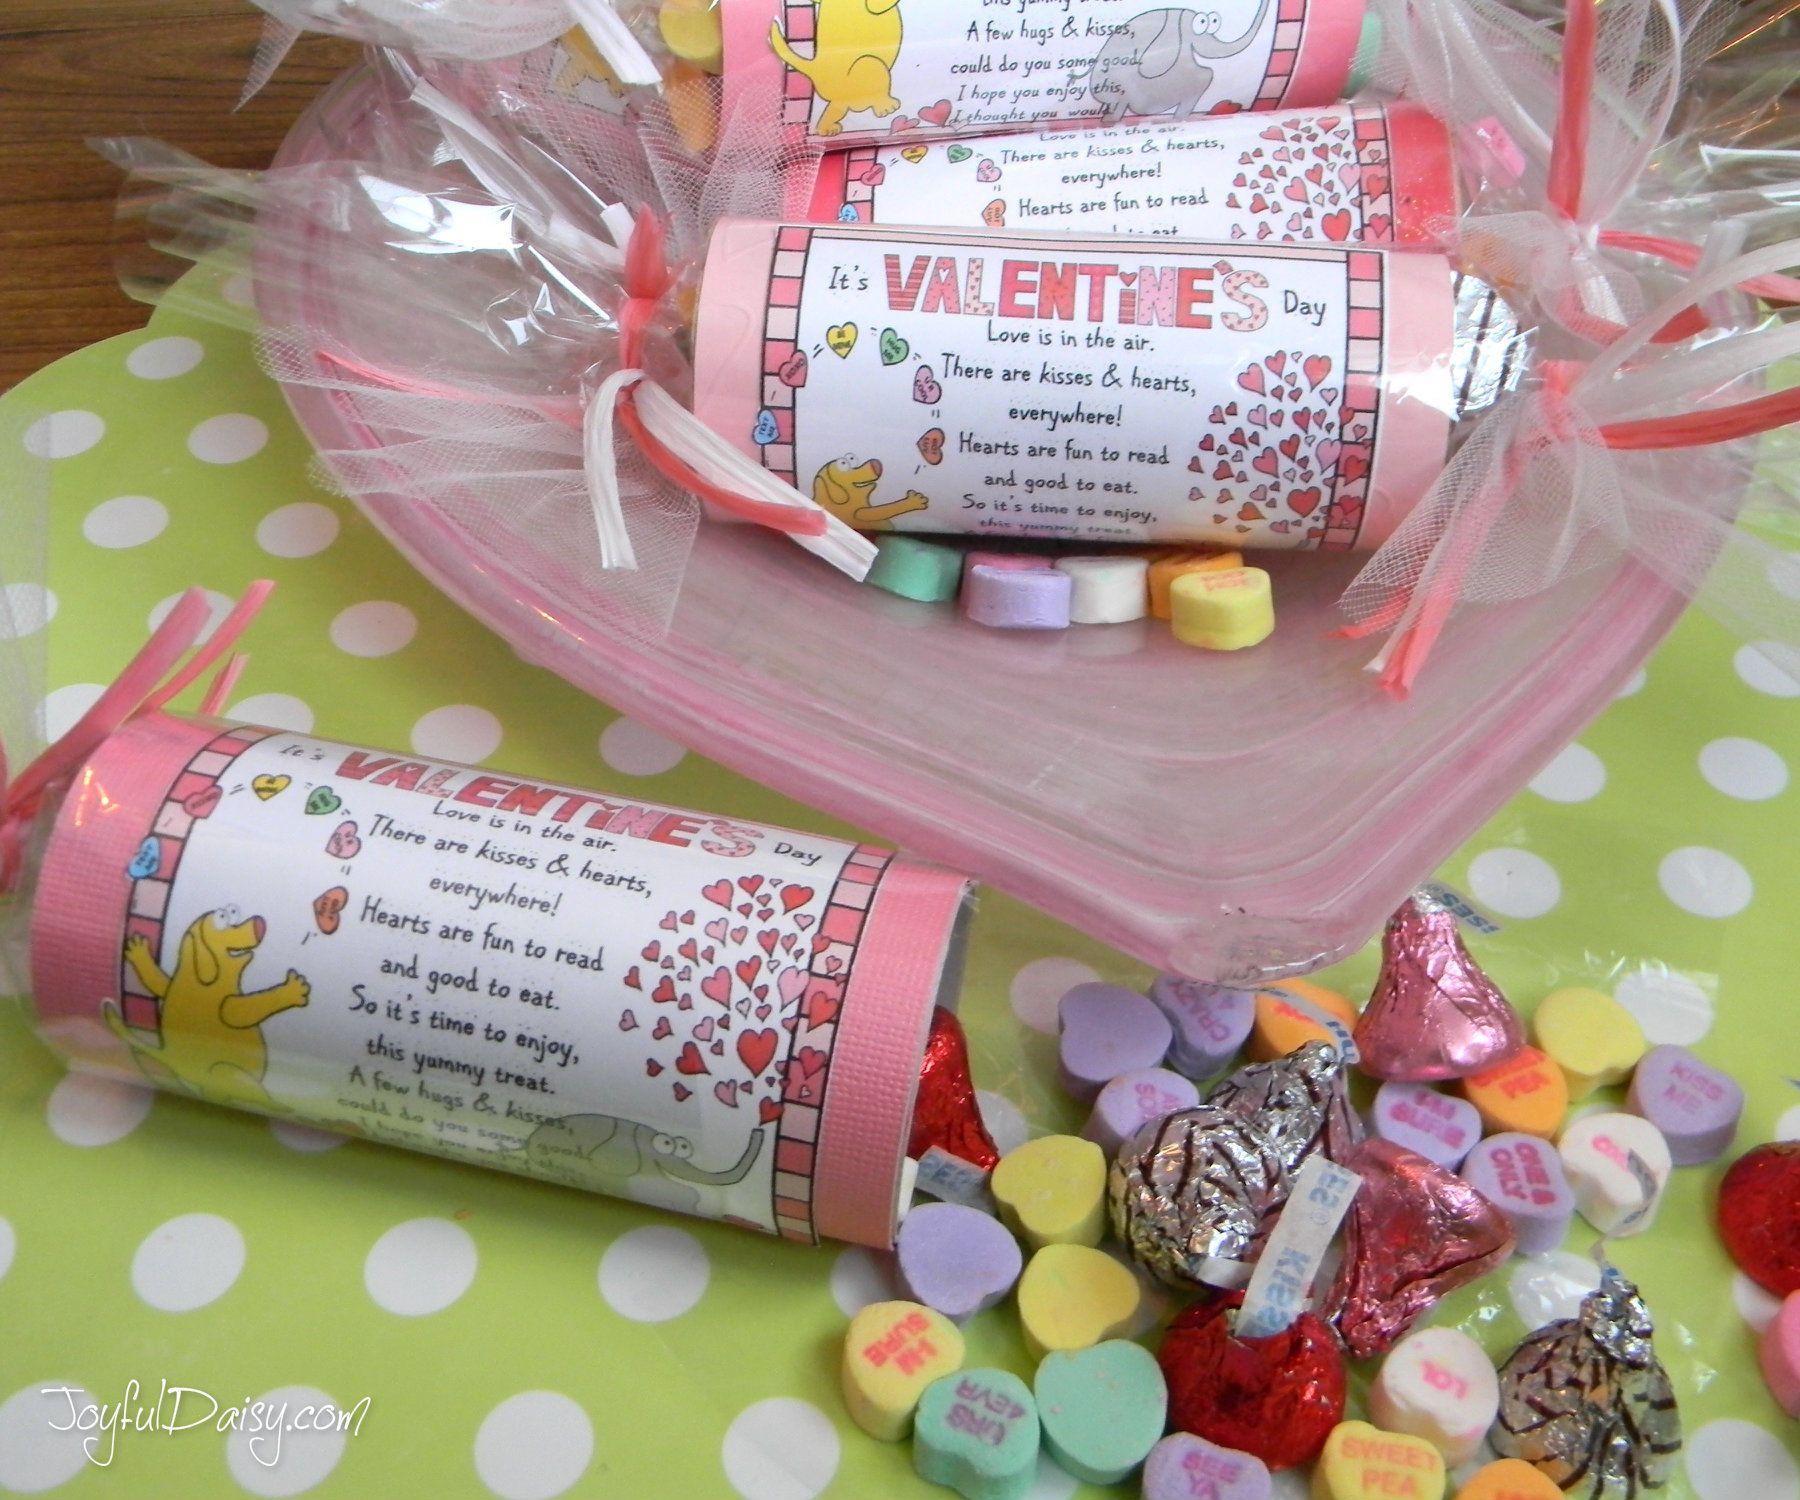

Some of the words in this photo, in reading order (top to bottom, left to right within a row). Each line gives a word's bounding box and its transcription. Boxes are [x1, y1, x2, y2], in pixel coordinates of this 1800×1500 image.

[966, 20, 979, 42] A
[986, 20, 1014, 42] few
[1020, 19, 1054, 46] hugs
[1062, 16, 1080, 39] &
[1085, 17, 1135, 40] kisses,
[950, 55, 993, 74] could
[999, 55, 1018, 72] do
[1025, 59, 1051, 78] you
[1058, 57, 1098, 70] some
[957, 85, 967, 101] I
[971, 85, 1006, 105] hope
[1013, 88, 1039, 103] you
[1046, 84, 1089, 102] enjoy
[1093, 78, 1126, 100] this,
[967, 108, 1025, 125] thought
[1032, 111, 1058, 124] you
[1039, 132, 1077, 142] Love
[1084, 131, 1096, 139] is
[1104, 129, 1119, 137] in
[1125, 126, 1149, 135] the
[1158, 125, 1184, 134] air.
[1001, 150, 1046, 165] There
[1054, 150, 1079, 161] are
[1086, 144, 1134, 158] kisses
[1141, 139, 1160, 153] &
[1167, 139, 1226, 151] hearts,
[1061, 161, 1162, 189] everywhere!
[1018, 198, 1073, 218] Hearts
[1080, 199, 1107, 214] are
[1113, 191, 1140, 212] fun
[1146, 192, 1163, 208] to
[1170, 187, 1209, 206] read
[828, 265, 869, 291] It's
[1284, 289, 1327, 326] Day
[987, 319, 1033, 345] Love
[1038, 328, 1055, 346] is
[1061, 328, 1080, 347] in
[1086, 327, 1117, 349] the
[1124, 333, 1155, 352] air.
[941, 352, 993, 380] There
[1002, 367, 1031, 382] are
[1039, 361, 1093, 387] kisses
[1102, 363, 1123, 388] &
[1131, 366, 1196, 397] hearts,
[1009, 401, 1123, 431] everywhere!
[959, 432, 1019, 457] Hearts
[1028, 443, 1057, 458] are
[1066, 439, 1093, 461] fun
[1101, 447, 1120, 463] to
[1128, 446, 1170, 465] read
[985, 470, 1017, 487] and
[1025, 473, 1068, 494] good
[1077, 477, 1095, 492] to
[1103, 481, 1137, 495] eat.
[962, 494, 986, 511] So
[993, 495, 1023, 512] it's
[1031, 502, 1068, 516] time
[1077, 505, 1095, 516] to
[1104, 508, 1157, 525] enjoy,
[280, 743, 325, 763] It's
[773, 841, 821, 867] Day
[433, 801, 481, 825] Love
[489, 812, 506, 829] is
[512, 817, 532, 835] in
[541, 821, 575, 843] the
[583, 834, 617, 852] air.
[370, 814, 424, 847] There
[434, 835, 469, 856] are
[477, 839, 537, 872] kisses
[546, 854, 573, 876] &
[579, 864, 652, 899] hearts,
[429, 873, 563, 917] everywhere!
[361, 895, 430, 935] Hearts
[439, 925, 474, 943] are
[483, 922, 514, 953] fun
[524, 939, 546, 959] to
[555, 946, 604, 971] read
[381, 954, 419, 979] and
[428, 966, 479, 995] good
[489, 979, 511, 998] to
[519, 989, 560, 1011] eat.
[349, 984, 378, 1015] So
[386, 993, 421, 1024] it's
[429, 1010, 475, 1036] time
[484, 1023, 507, 1043] to
[516, 1033, 579, 1068] enjoy,
[367, 1033, 405, 1062] this
[414, 1051, 485, 1087] yummy
[495, 1067, 555, 1095] treat.
[349, 1065, 365, 1087] A
[373, 1070, 410, 1097] few
[418, 1080, 464, 1112] hugs
[473, 1092, 497, 1115] &
[505, 1100, 574, 1136] kisses,
[1490, 1147, 1528, 1200] ONLY
[1341, 1437, 1437, 1471] SWEET
[1361, 1469, 1418, 1497] PEA
